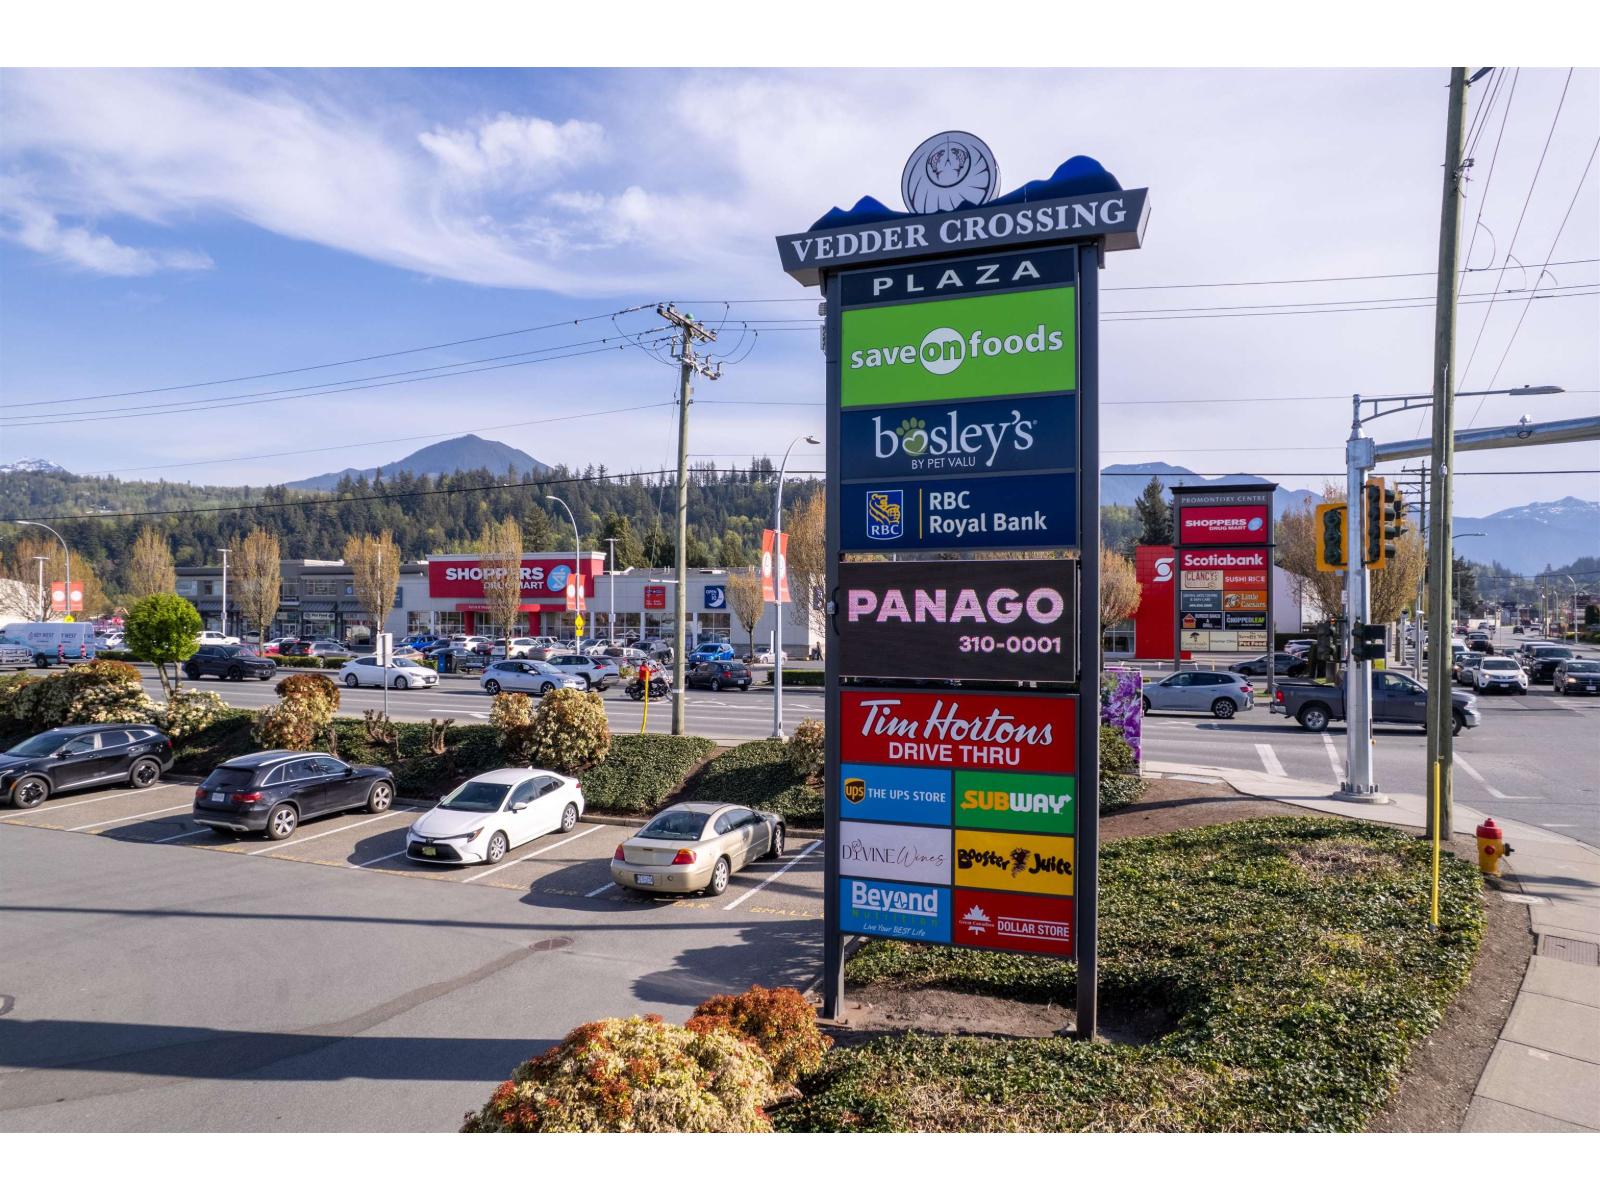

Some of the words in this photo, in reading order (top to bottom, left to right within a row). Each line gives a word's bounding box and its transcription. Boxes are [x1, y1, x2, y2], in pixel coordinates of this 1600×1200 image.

[791, 224, 929, 263] VEDDER
[939, 197, 1127, 245] CROSSING
[873, 259, 1041, 297] PLAZA
[850, 344, 917, 369] save
[921, 339, 962, 363] on
[969, 324, 1064, 358] foods
[911, 459, 924, 470] BY
[927, 458, 945, 469] PET
[948, 456, 976, 468] VALU
[929, 490, 971, 511] RBC
[871, 524, 900, 536] RBC
[929, 513, 987, 537] Royal
[993, 511, 1048, 532] Bank
[1184, 518, 1247, 527] SHOPPERS
[1184, 553, 1264, 566] Scotiabank
[445, 567, 545, 581] SHOPPRS
[847, 587, 1064, 624] PANAGO
[958, 635, 1062, 654] 310-0001
[859, 699, 919, 739] Tim
[923, 699, 1053, 746] Hortons
[889, 742, 953, 763] DRIVE
[958, 744, 1021, 766] THRU
[845, 784, 864, 801] ups
[868, 787, 887, 799] THE
[889, 789, 910, 801] UPS
[913, 791, 946, 803] STORE
[960, 789, 1072, 815] SUBWAY
[896, 845, 945, 868] Wines
[957, 848, 1010, 870] Booster
[1028, 853, 1073, 876] Juice
[852, 880, 938, 913] Beyond
[750, 904, 814, 917] SMALL
[863, 922, 877, 930] Live
[878, 923, 893, 932] Your
[893, 926, 912, 936] BEST
[911, 928, 926, 937] Life
[997, 920, 1035, 935] DOLLAR
[1037, 924, 1070, 938] STORE
